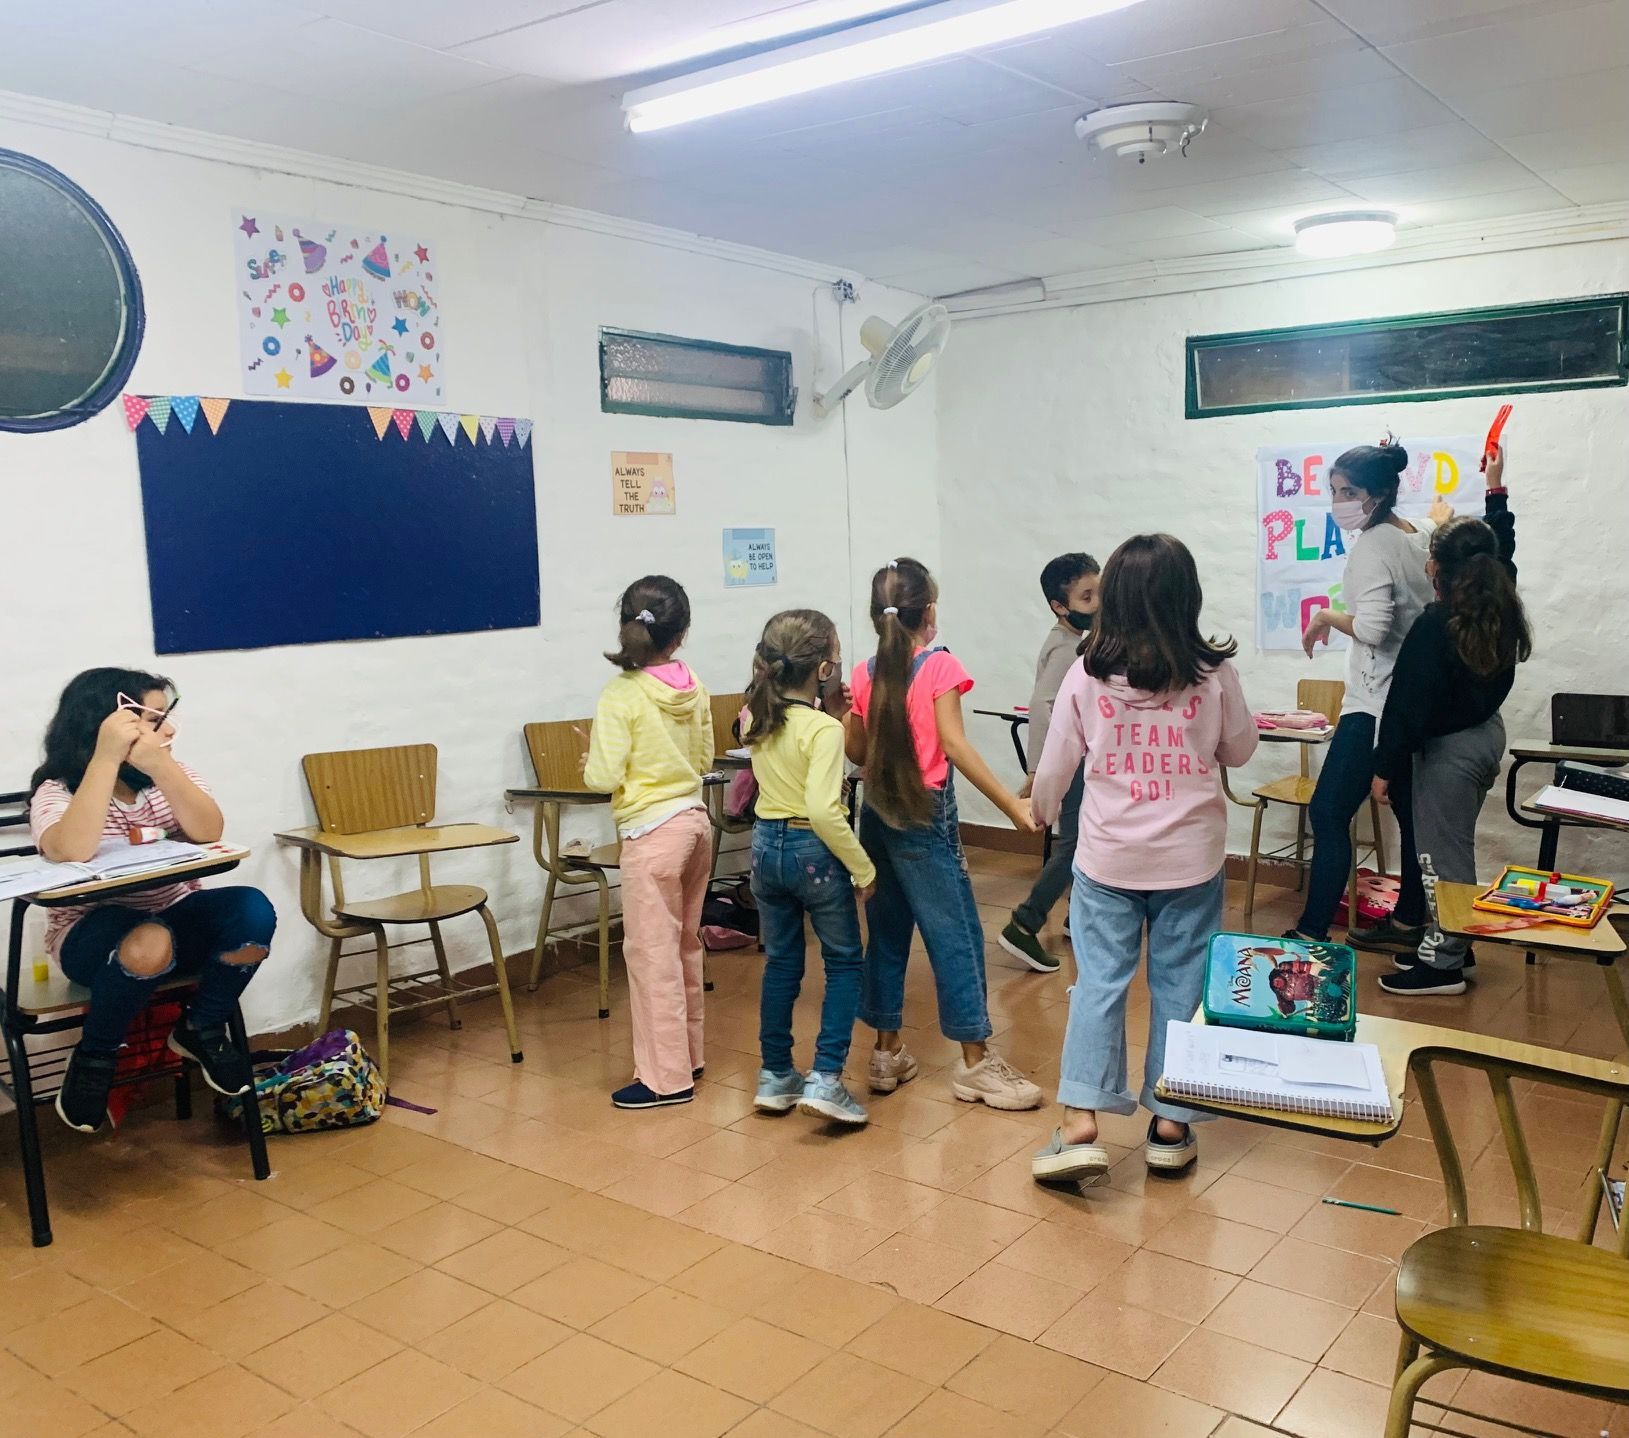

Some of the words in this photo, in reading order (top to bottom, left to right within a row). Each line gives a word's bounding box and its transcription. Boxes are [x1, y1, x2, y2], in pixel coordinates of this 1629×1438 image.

[615, 467, 646, 477] ALWAYS
[1275, 454, 1324, 498] BE
[620, 479, 642, 489] TELL
[624, 492, 640, 501] THE
[619, 503, 645, 513] TRUTH
[1262, 509, 1346, 561] PLA
[748, 543, 771, 551] ALWAYS
[749, 553, 757, 561] BE
[758, 553, 773, 561] OPEN
[758, 562, 774, 571] HELP
[1113, 723, 1185, 748] TEAM
[1129, 779, 1173, 801] GO!
[1232, 946, 1253, 1008] MOANA
